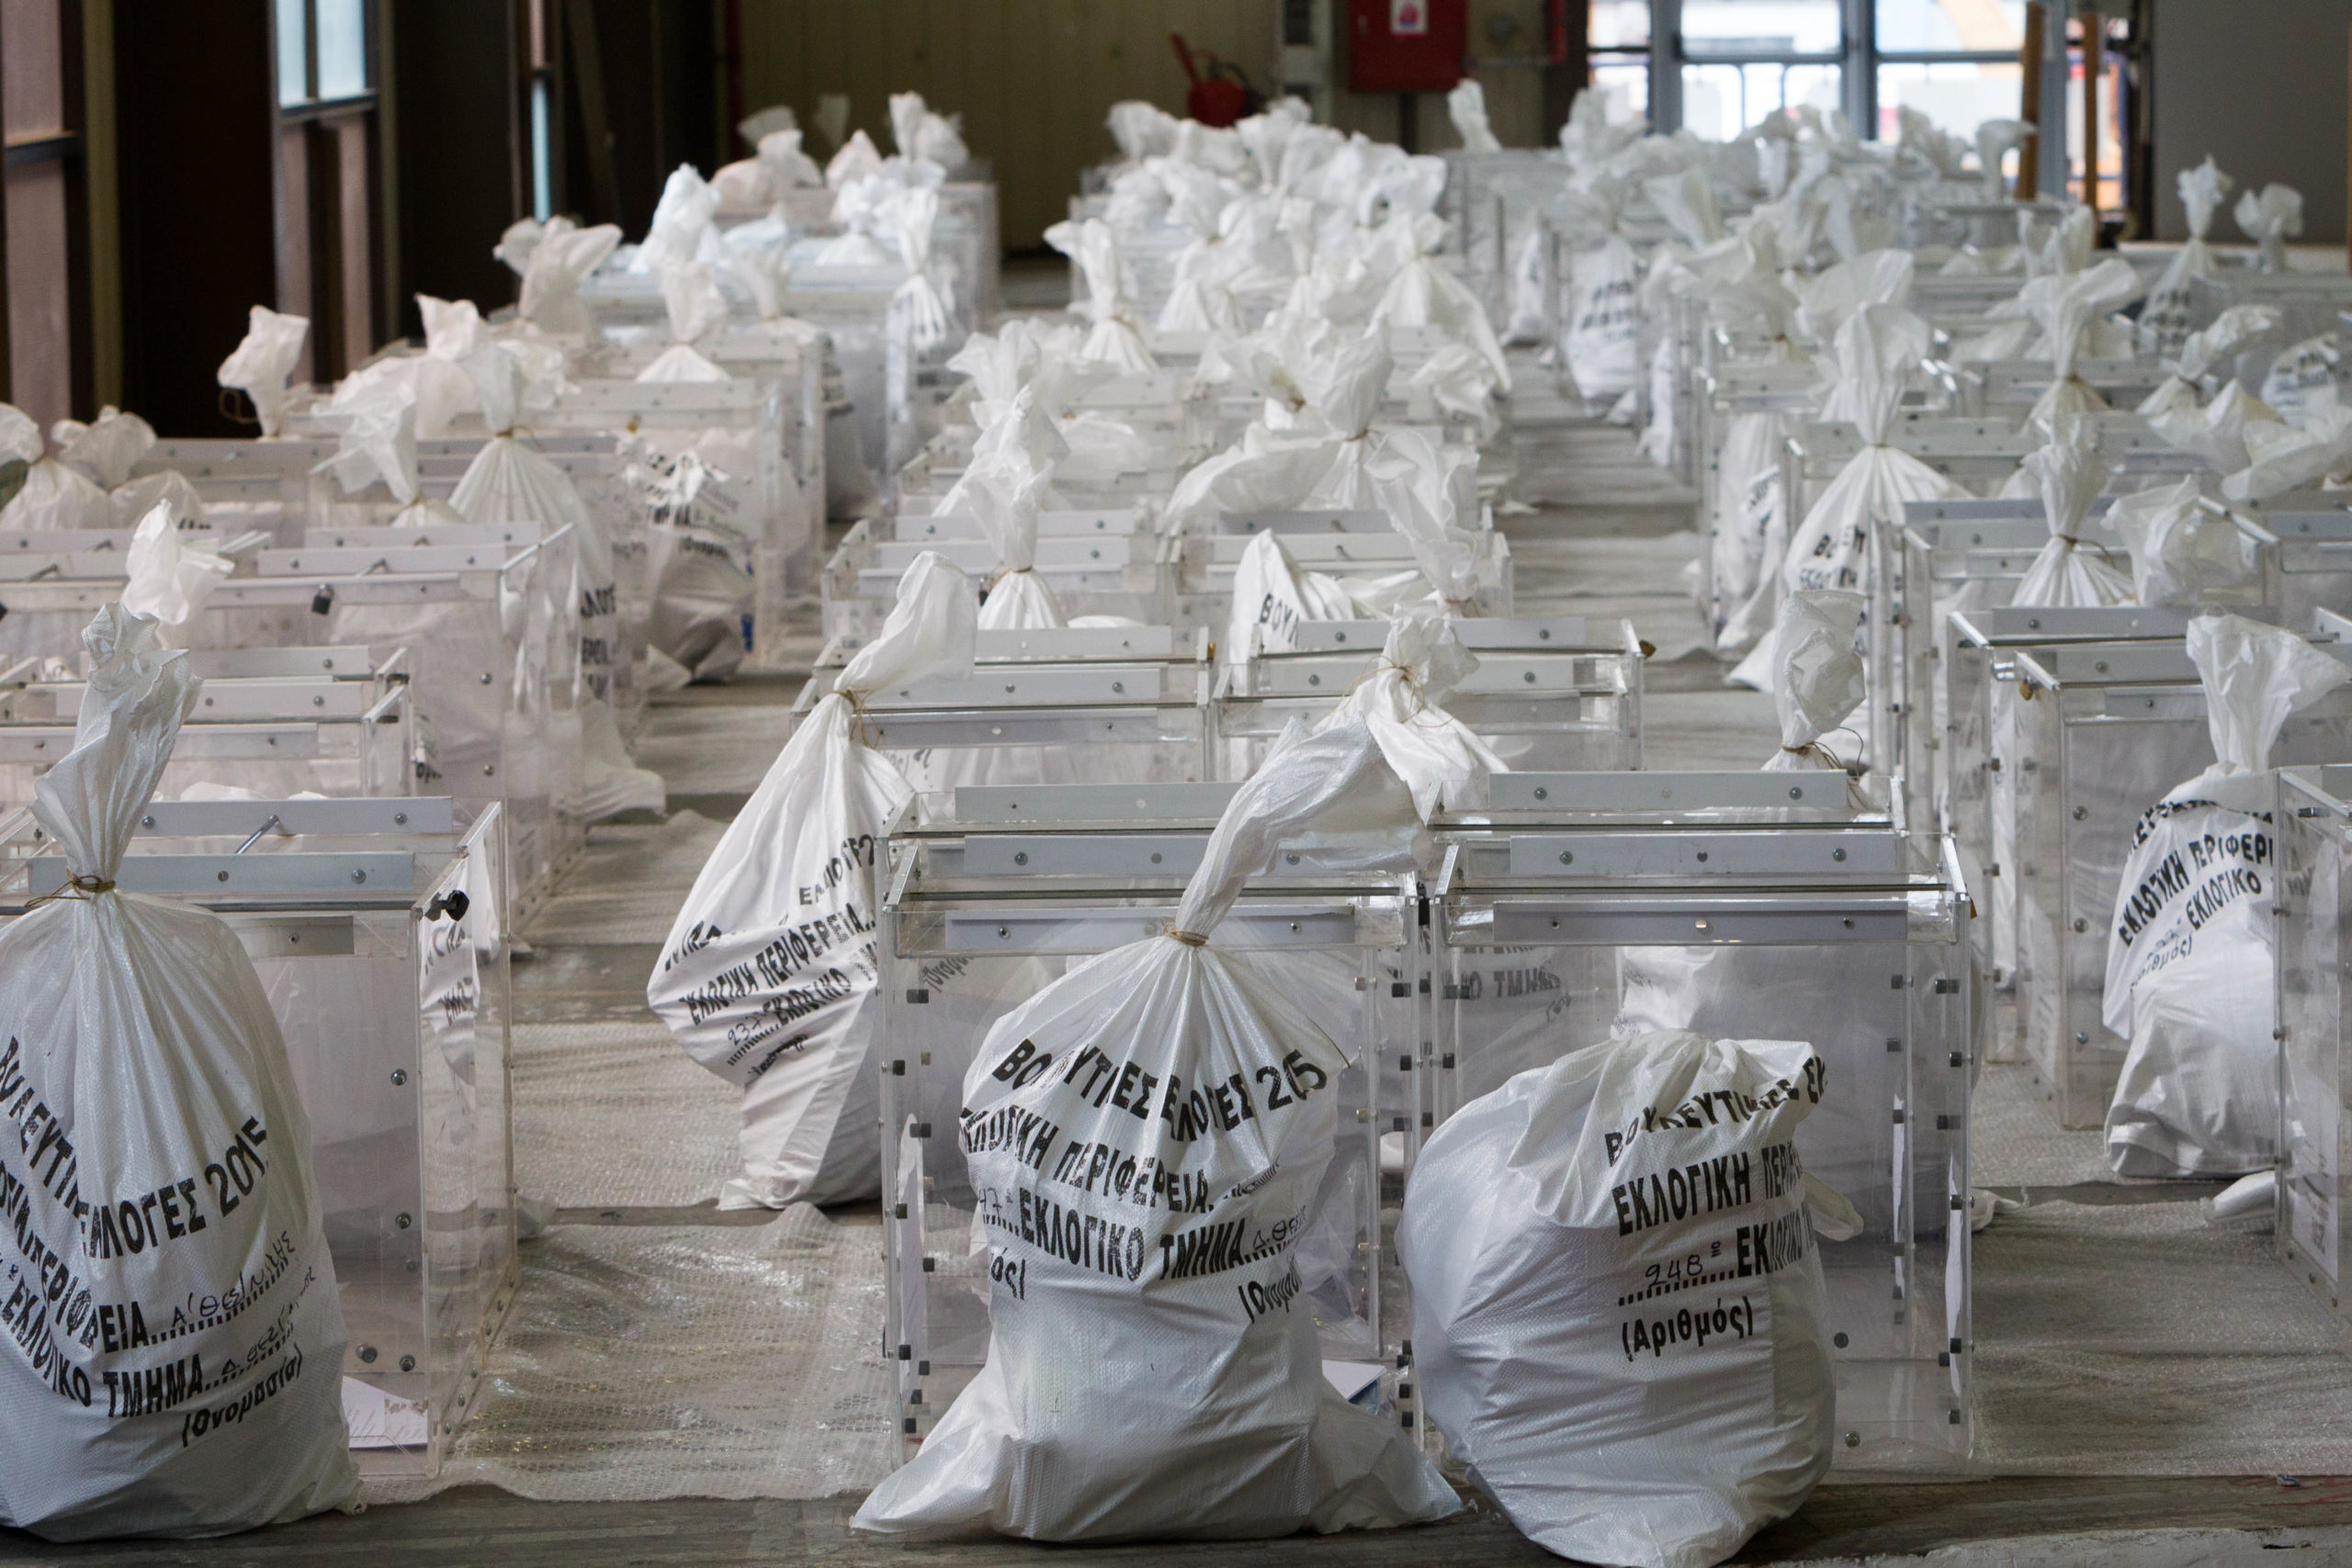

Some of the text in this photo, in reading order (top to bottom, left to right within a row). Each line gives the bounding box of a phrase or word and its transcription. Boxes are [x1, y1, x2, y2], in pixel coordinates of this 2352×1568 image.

[2186, 867, 2262, 931] ΕΚΛΟΓΙΚΟ
[1611, 1151, 1751, 1237] ΕΚΛΟΓΙΚΗ
[1019, 1187, 1246, 1282] ΕΚΛΟΓΙΚΟ ΤΜΗΜΑ
[1622, 1295, 1754, 1363] (Αριθμός)
[102, 1354, 204, 1419] ΤΜΗΜΑ
